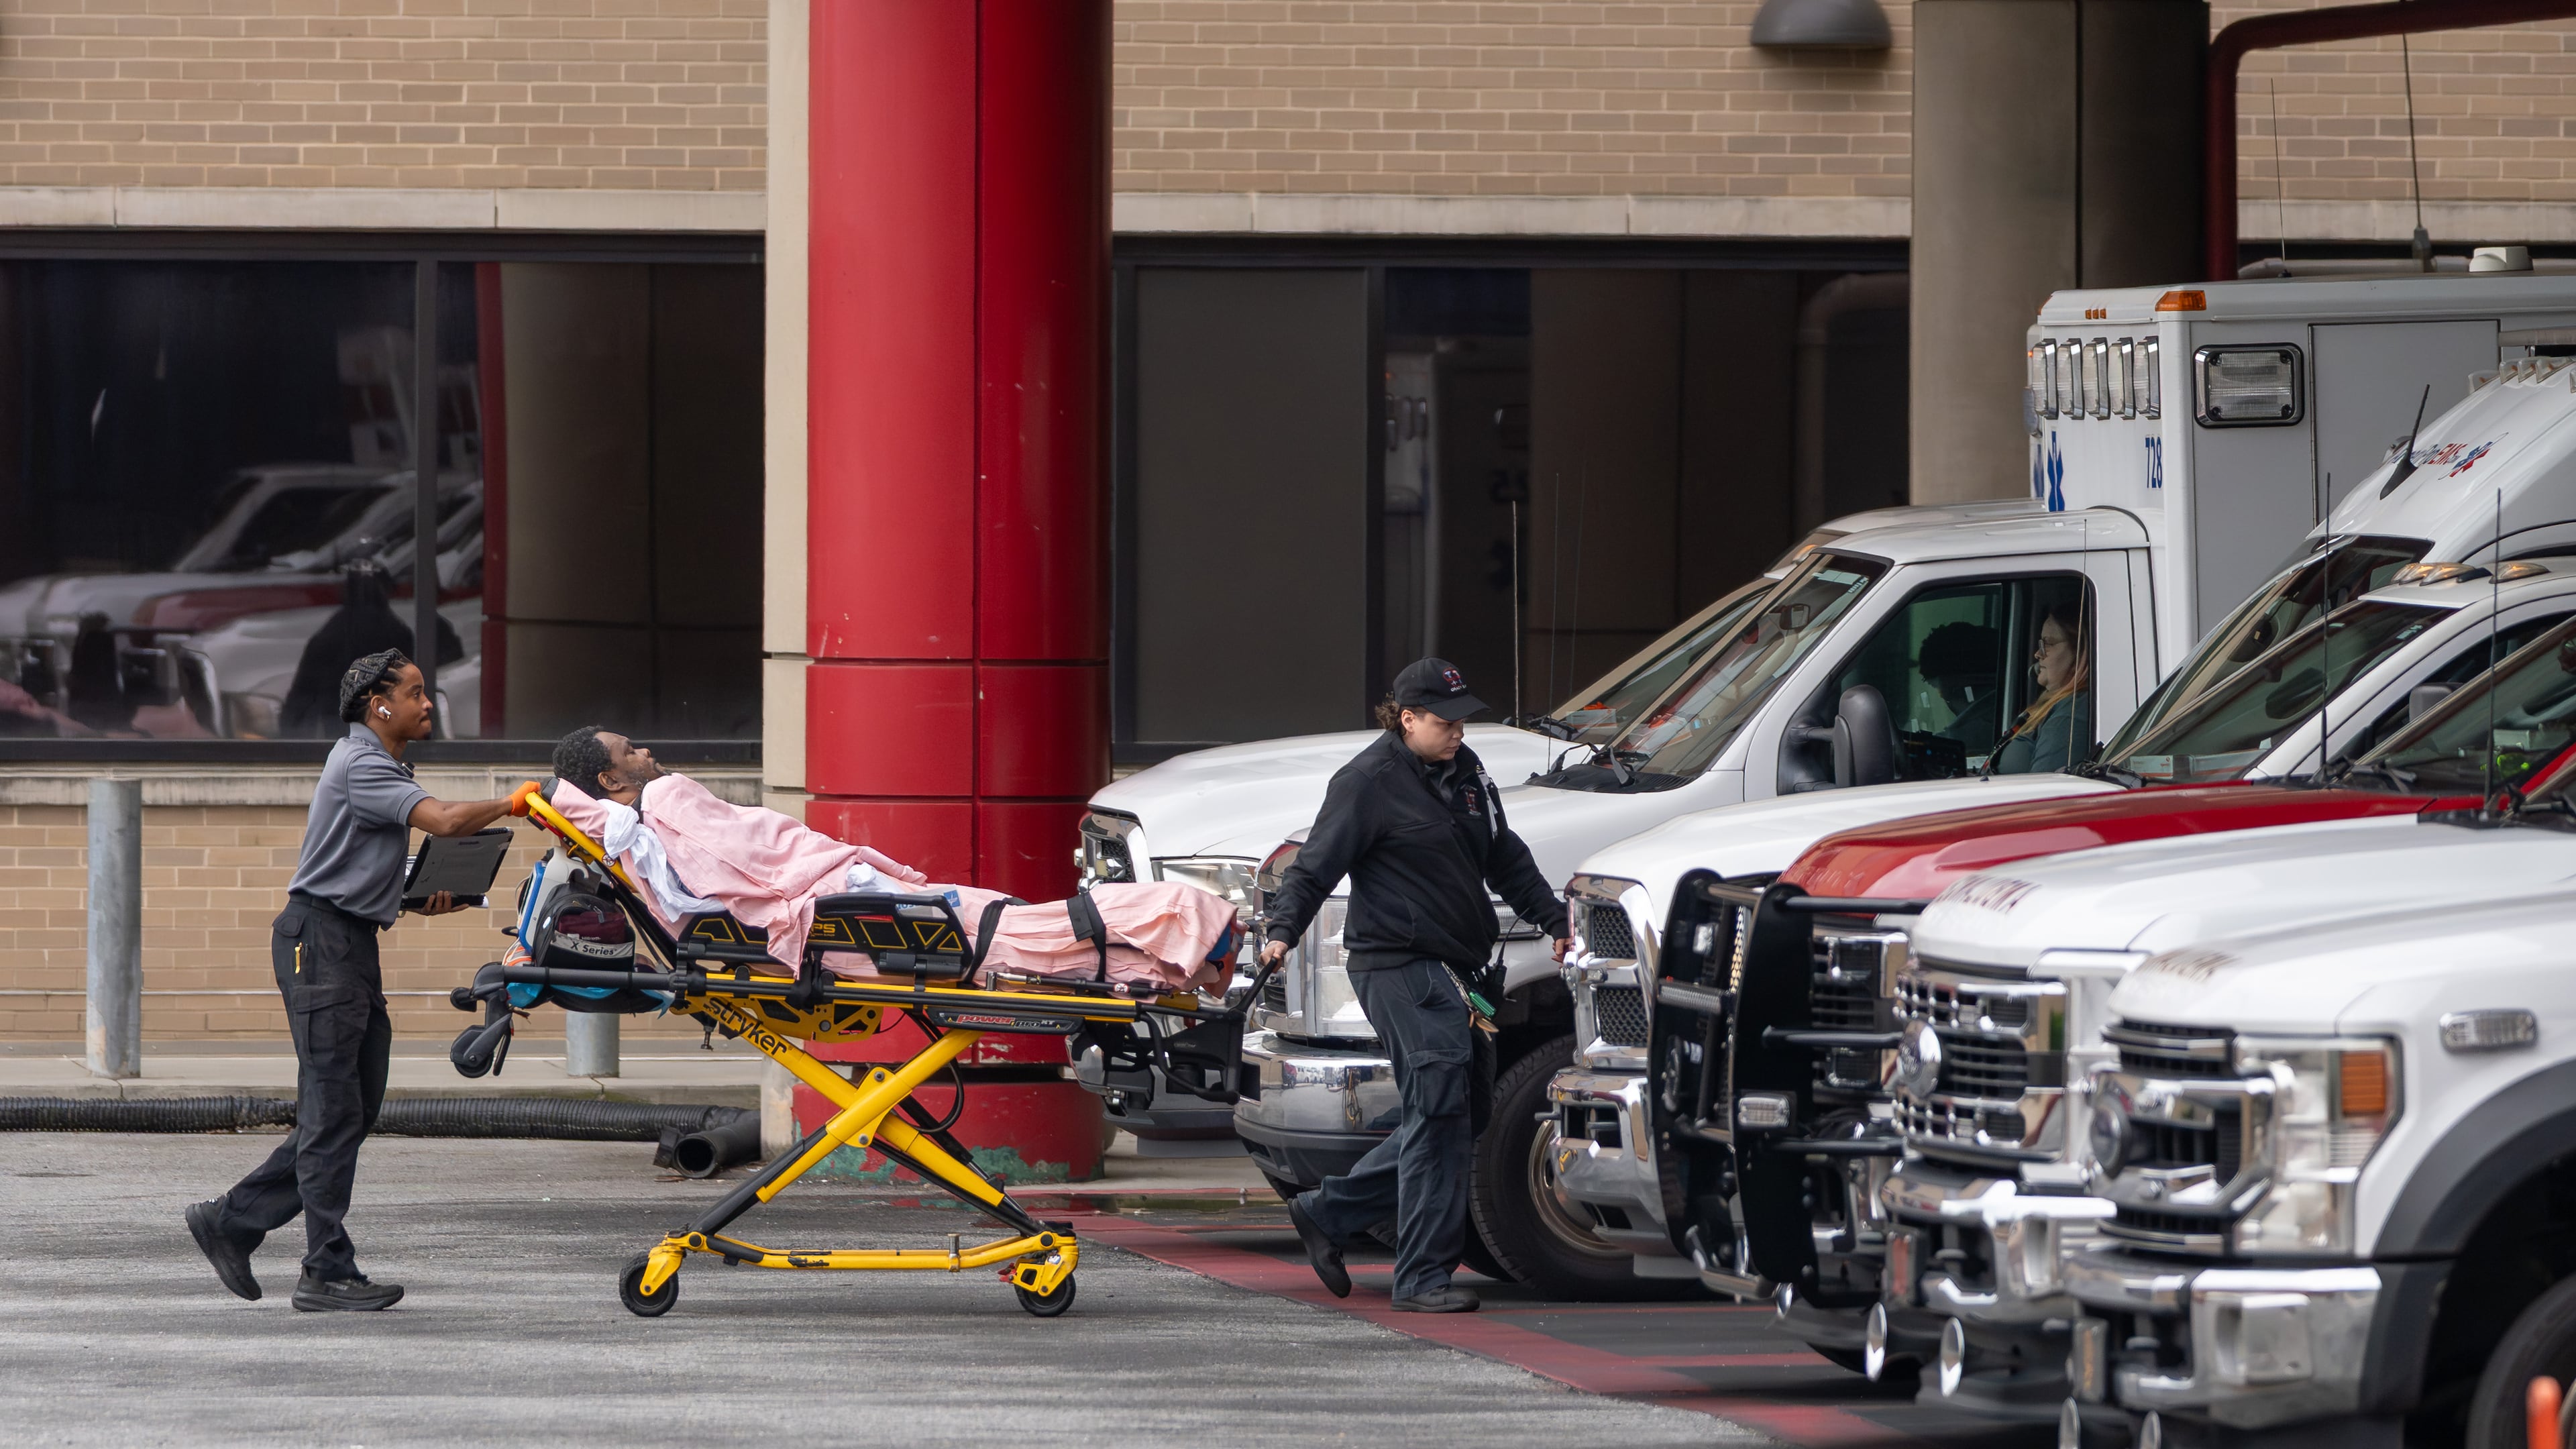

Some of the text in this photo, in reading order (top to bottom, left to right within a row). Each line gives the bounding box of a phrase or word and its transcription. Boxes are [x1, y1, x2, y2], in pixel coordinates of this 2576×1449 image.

[2145, 437, 2163, 489] 728
[571, 941, 614, 955] X Series
[709, 997, 788, 1056] stryker
[956, 1014, 1016, 1024] power
